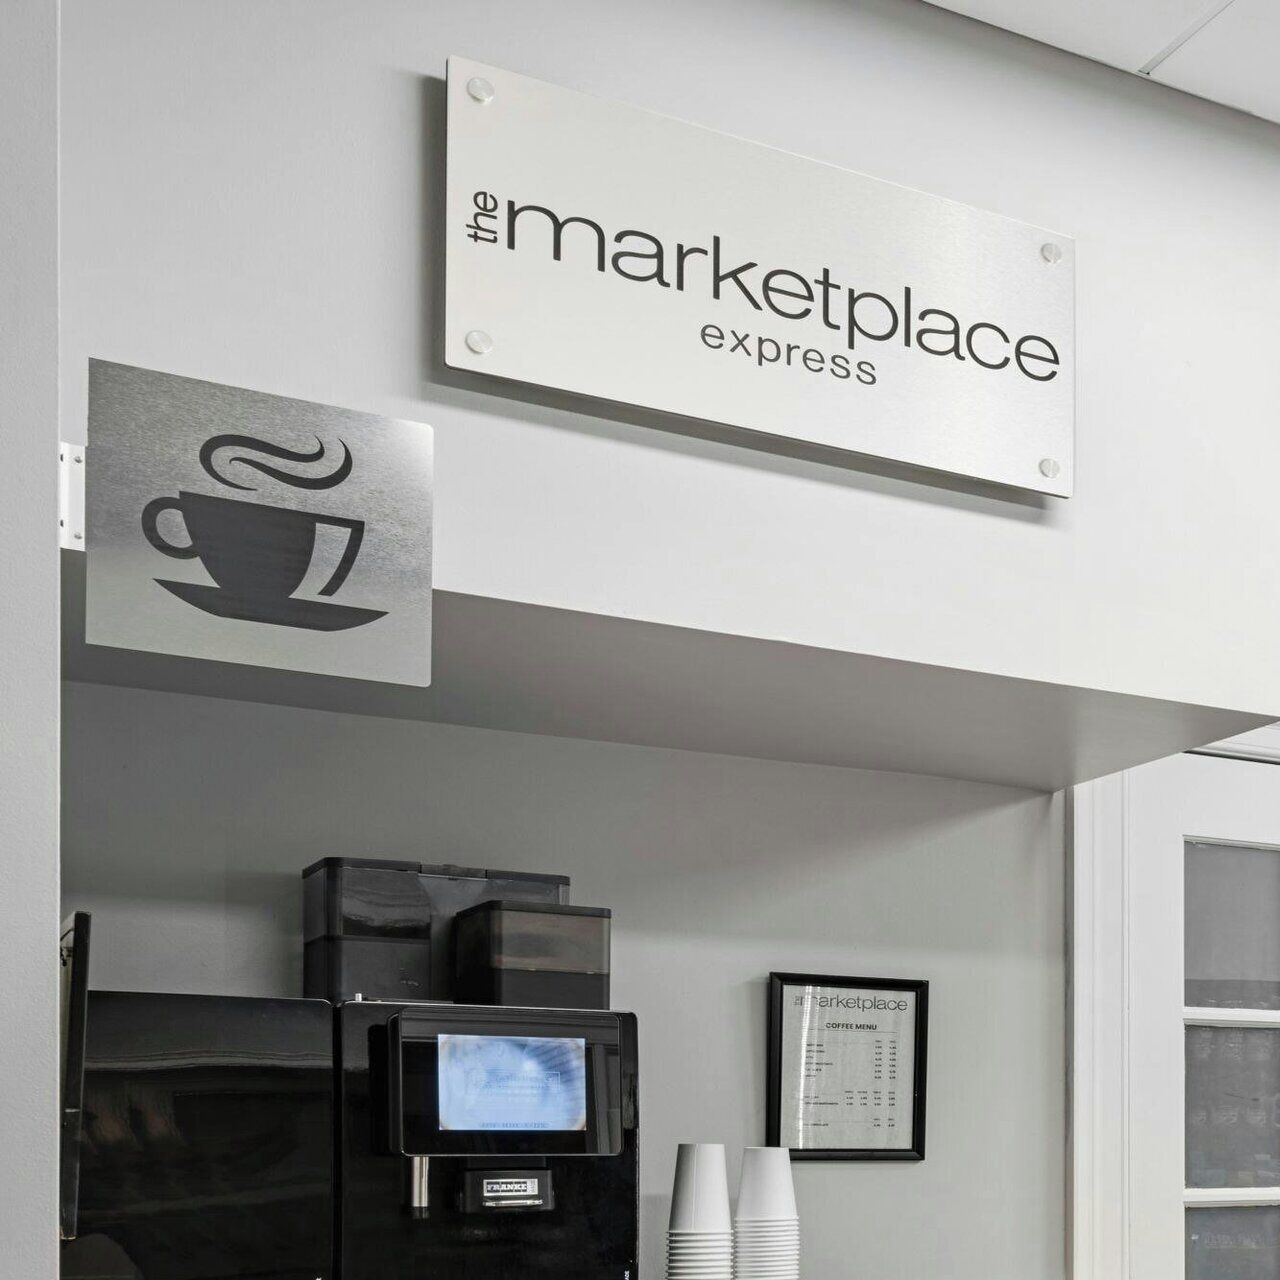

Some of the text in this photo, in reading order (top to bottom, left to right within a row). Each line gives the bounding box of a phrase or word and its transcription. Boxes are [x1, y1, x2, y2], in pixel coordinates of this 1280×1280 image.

[467, 191, 1060, 382] the marketplace
[700, 323, 877, 386] express
[487, 1183, 527, 1191] FRANKE
